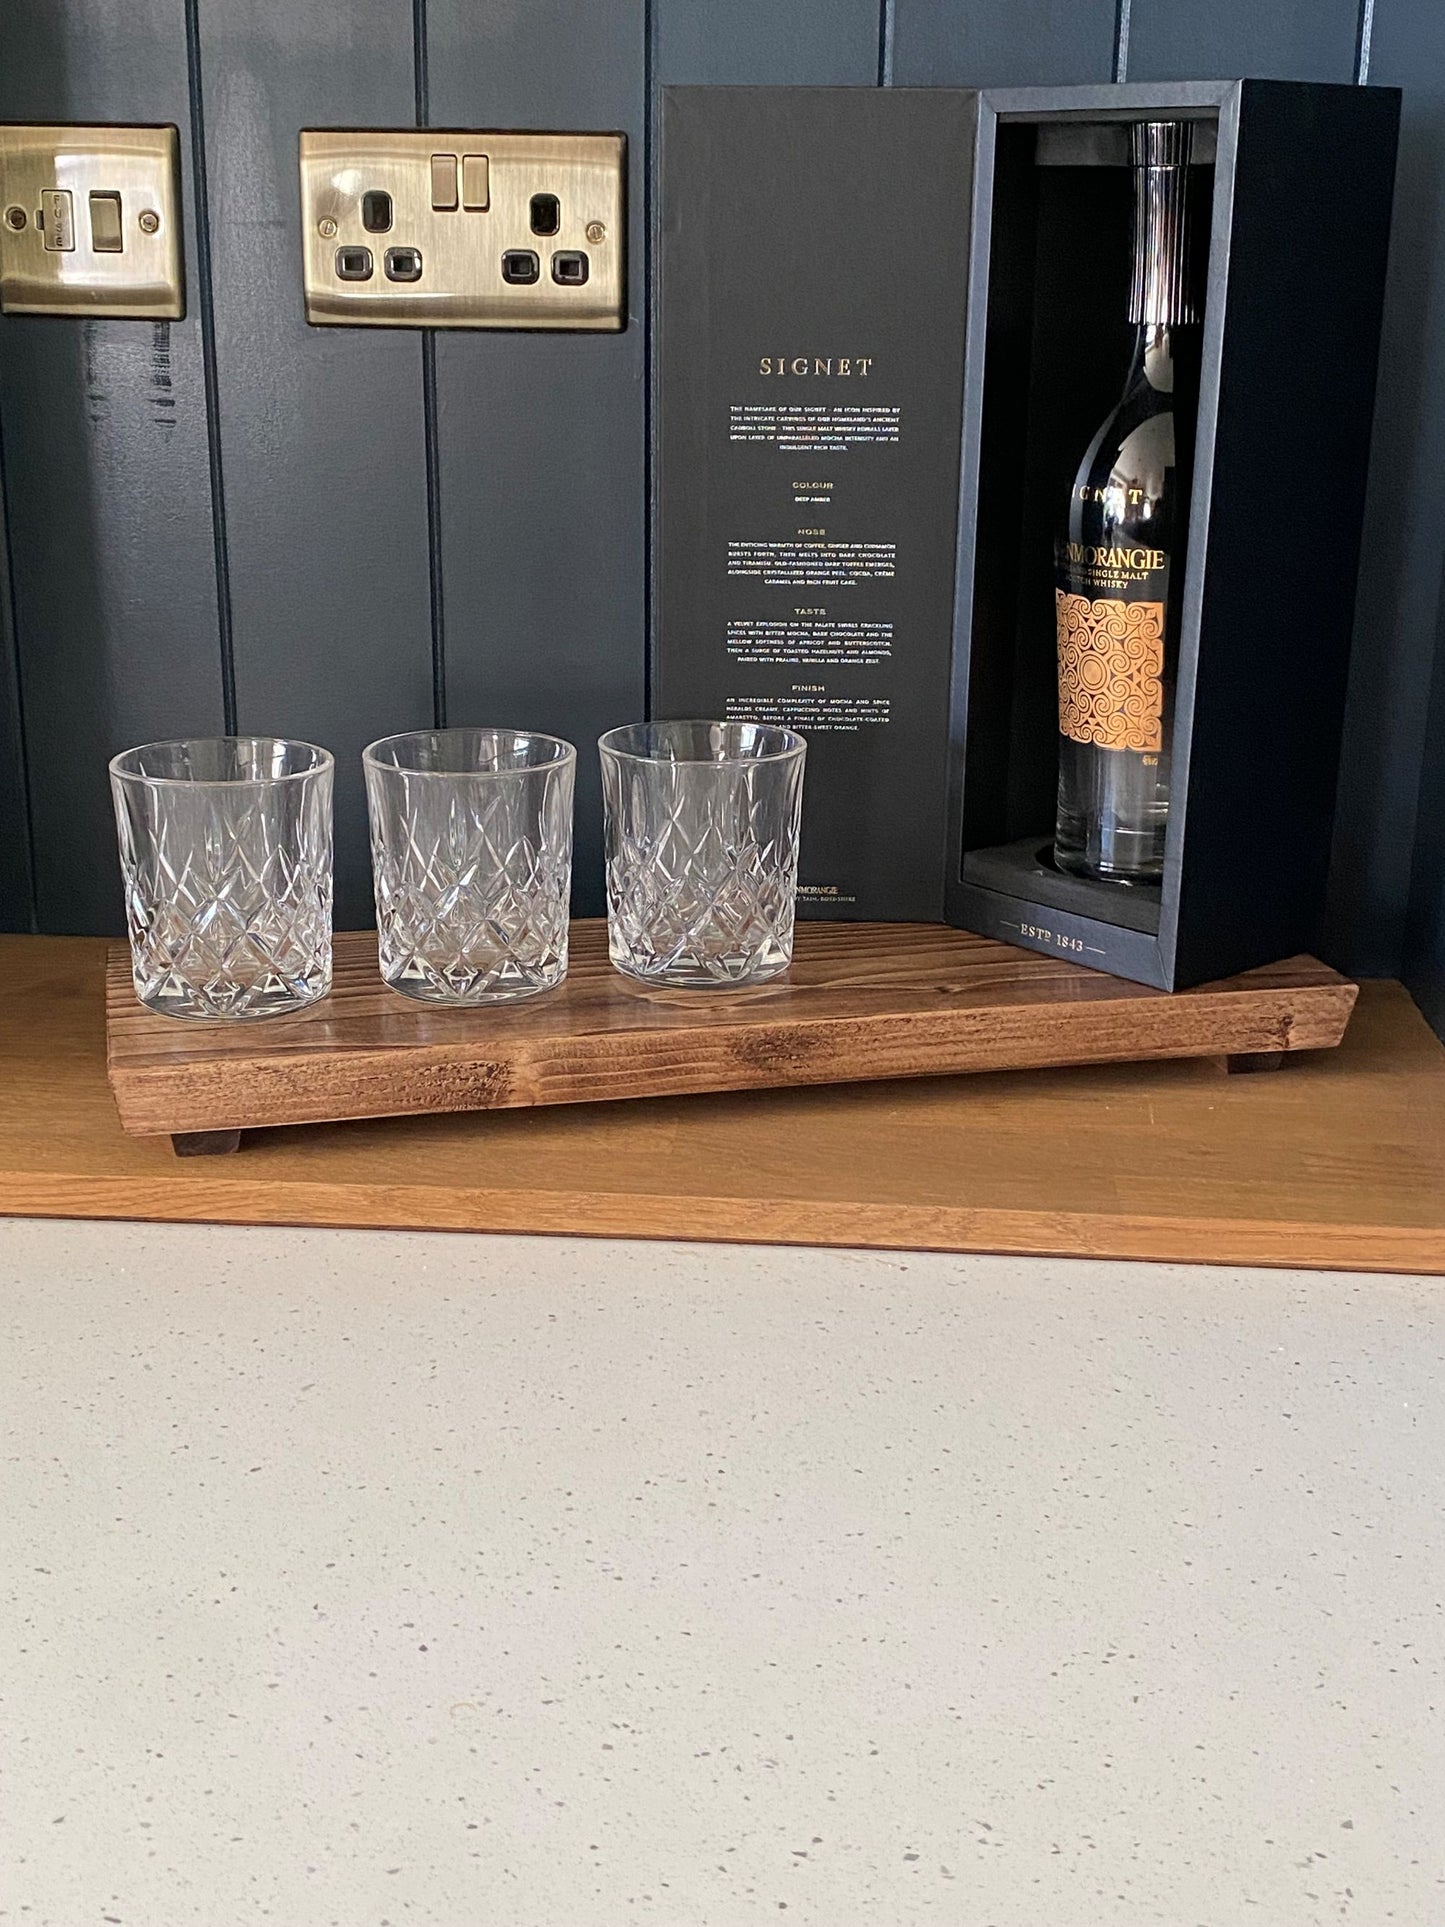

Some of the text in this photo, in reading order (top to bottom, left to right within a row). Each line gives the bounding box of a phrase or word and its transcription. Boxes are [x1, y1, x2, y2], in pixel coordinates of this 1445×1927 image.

[54, 194, 62, 246] FUSE
[760, 358, 872, 376] SIGNET
[1093, 577, 1128, 589] WHISKY
[1120, 571, 1148, 580] MALT
[1056, 934, 1083, 952] 1843
